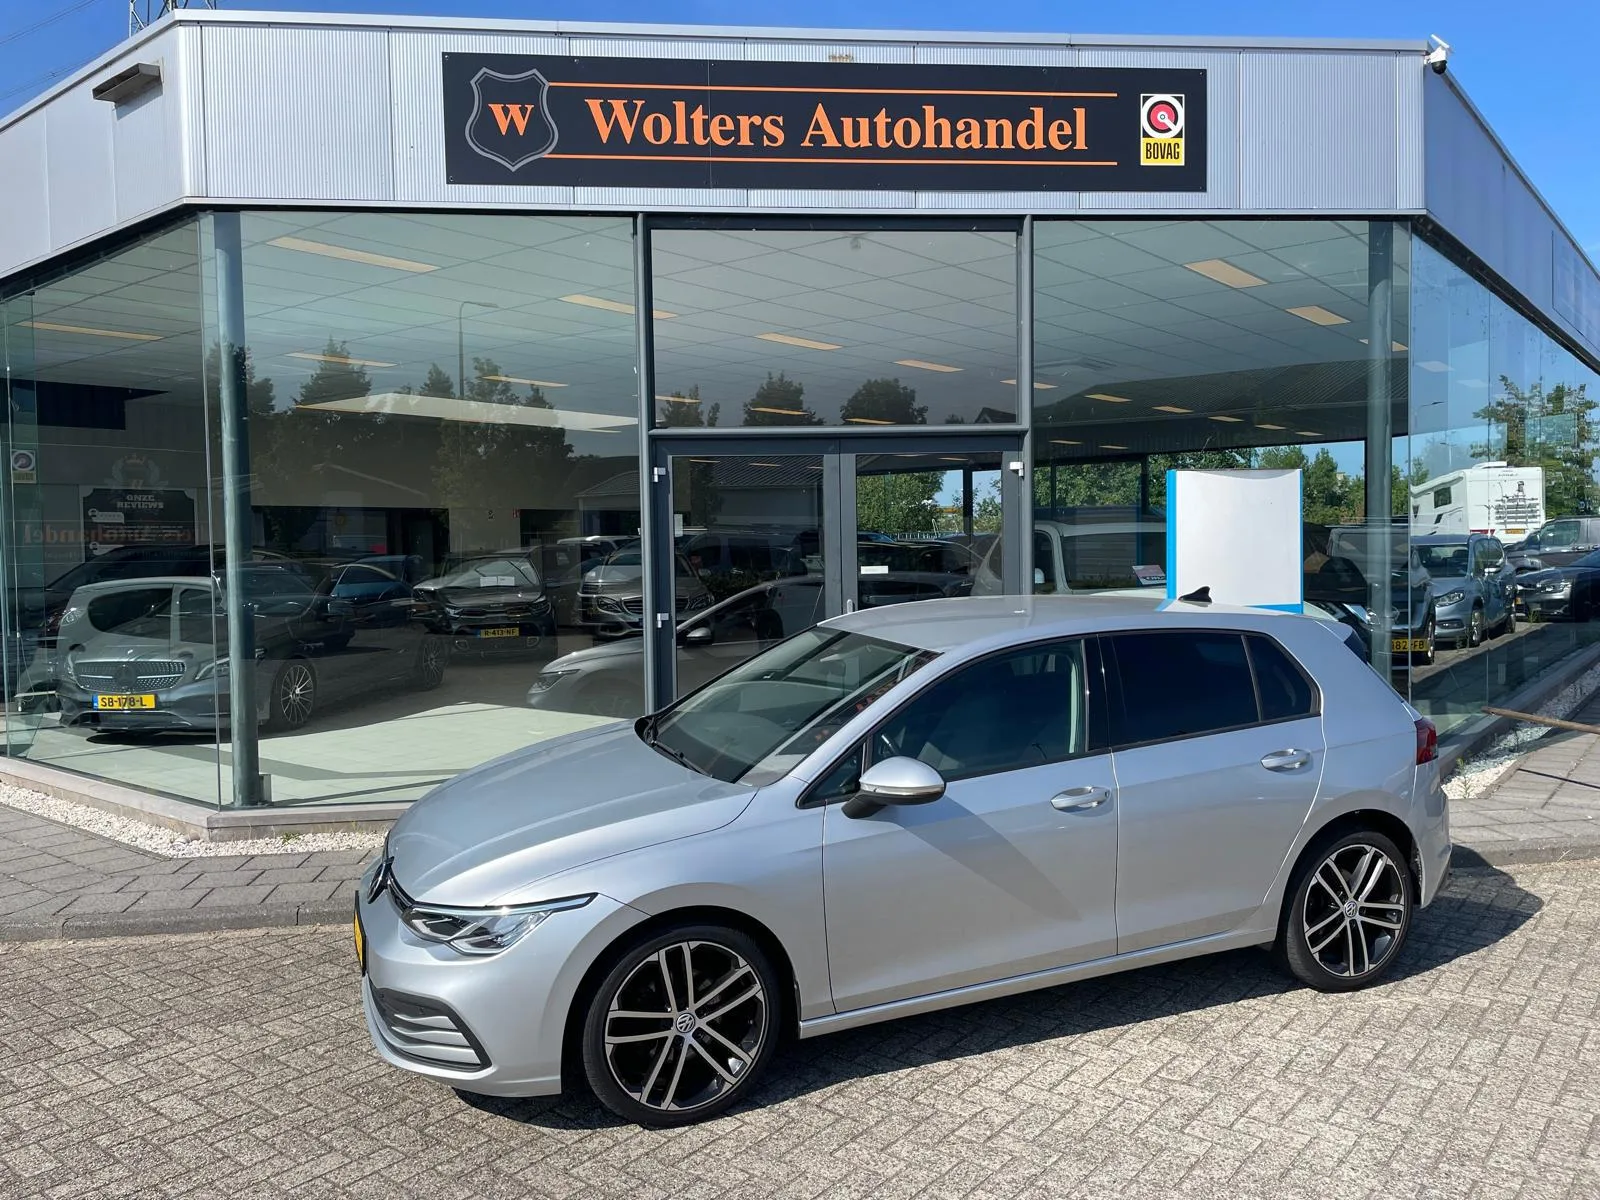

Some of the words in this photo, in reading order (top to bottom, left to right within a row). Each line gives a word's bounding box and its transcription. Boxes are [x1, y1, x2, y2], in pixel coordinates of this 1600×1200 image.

[488, 103, 535, 136] W
[584, 98, 786, 148] Wolters
[801, 102, 1089, 151] Autohandel
[1145, 142, 1180, 160] BOVAG
[100, 696, 147, 707] SB-178-L
